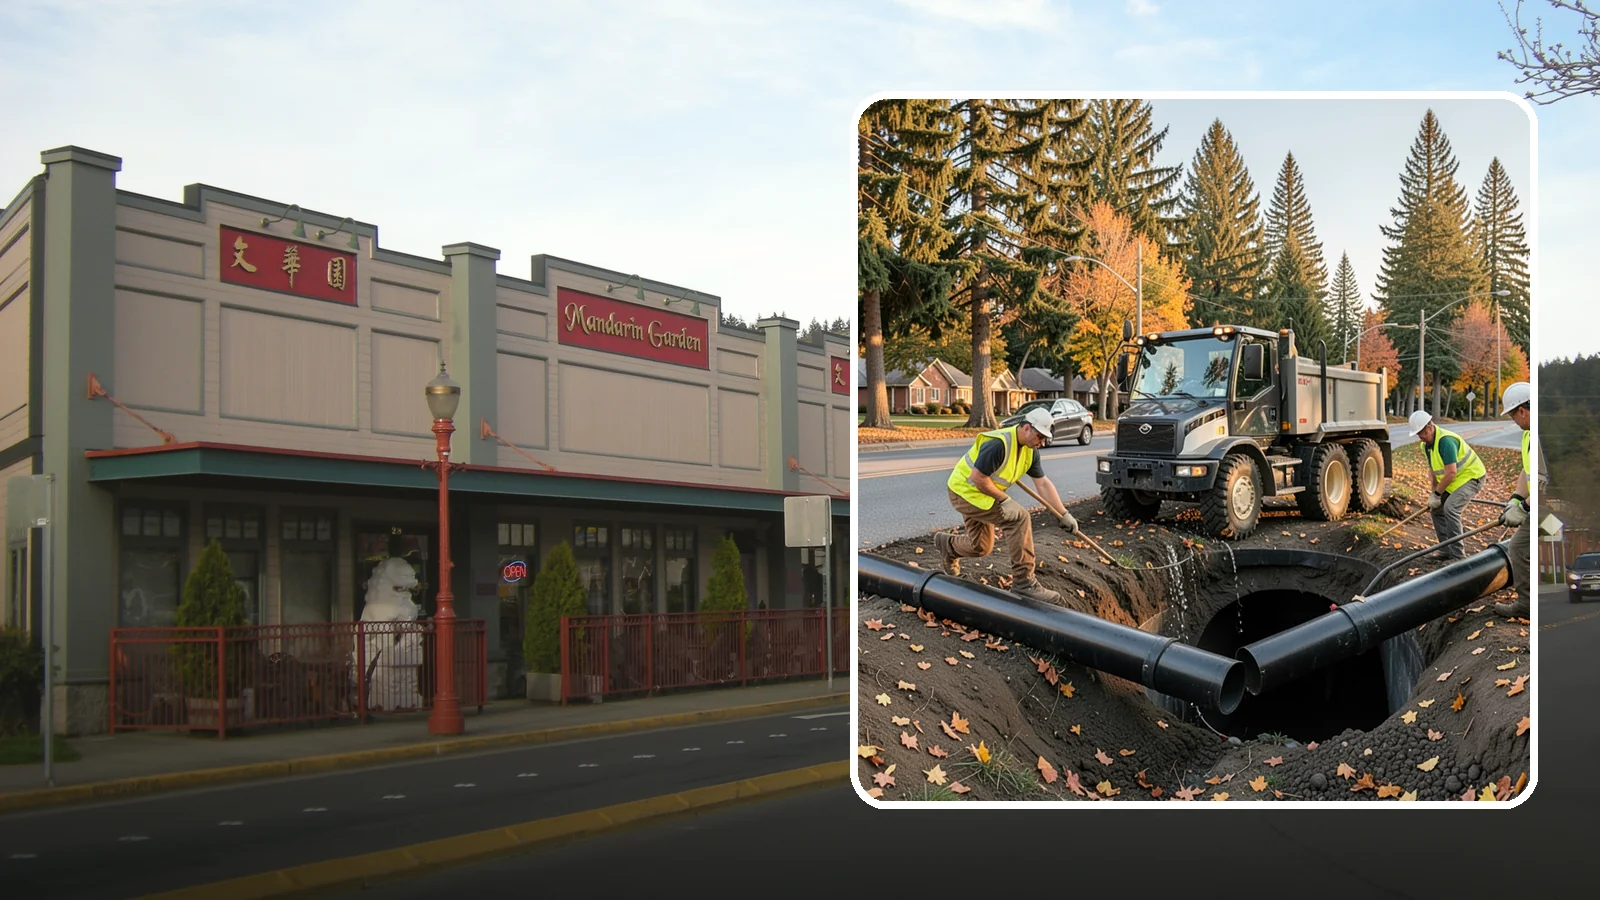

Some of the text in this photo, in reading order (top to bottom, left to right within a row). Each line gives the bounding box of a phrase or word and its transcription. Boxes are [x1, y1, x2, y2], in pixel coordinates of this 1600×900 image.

[231, 236, 346, 290] 文華園
[565, 302, 701, 352] Mandarin Garden
[503, 565, 526, 578] OPEN
